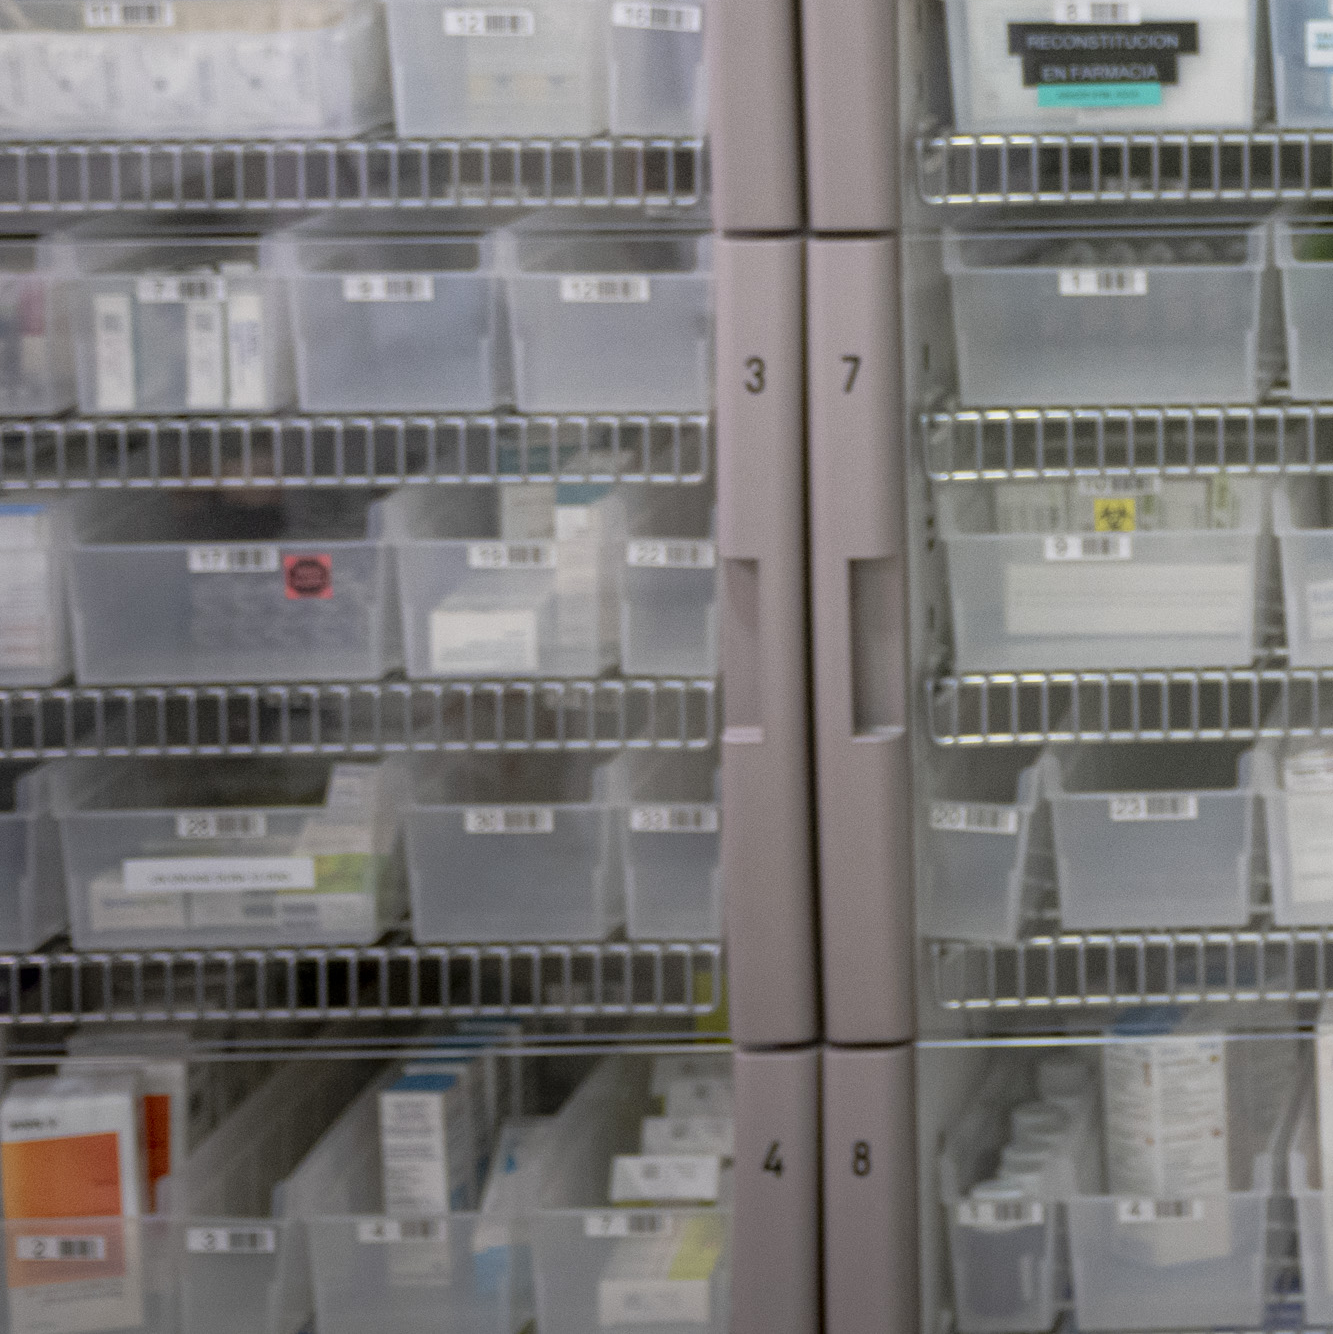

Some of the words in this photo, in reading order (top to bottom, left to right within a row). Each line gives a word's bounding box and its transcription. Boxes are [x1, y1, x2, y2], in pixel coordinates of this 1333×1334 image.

[1026, 34, 1180, 52] RECONSTITUCION
[1041, 65, 1068, 82] EN
[1070, 63, 1160, 82] FARMACIA
[744, 356, 765, 394] 3
[840, 355, 862, 392] 7
[763, 1142, 783, 1178] 4
[851, 1141, 871, 1176] 8
